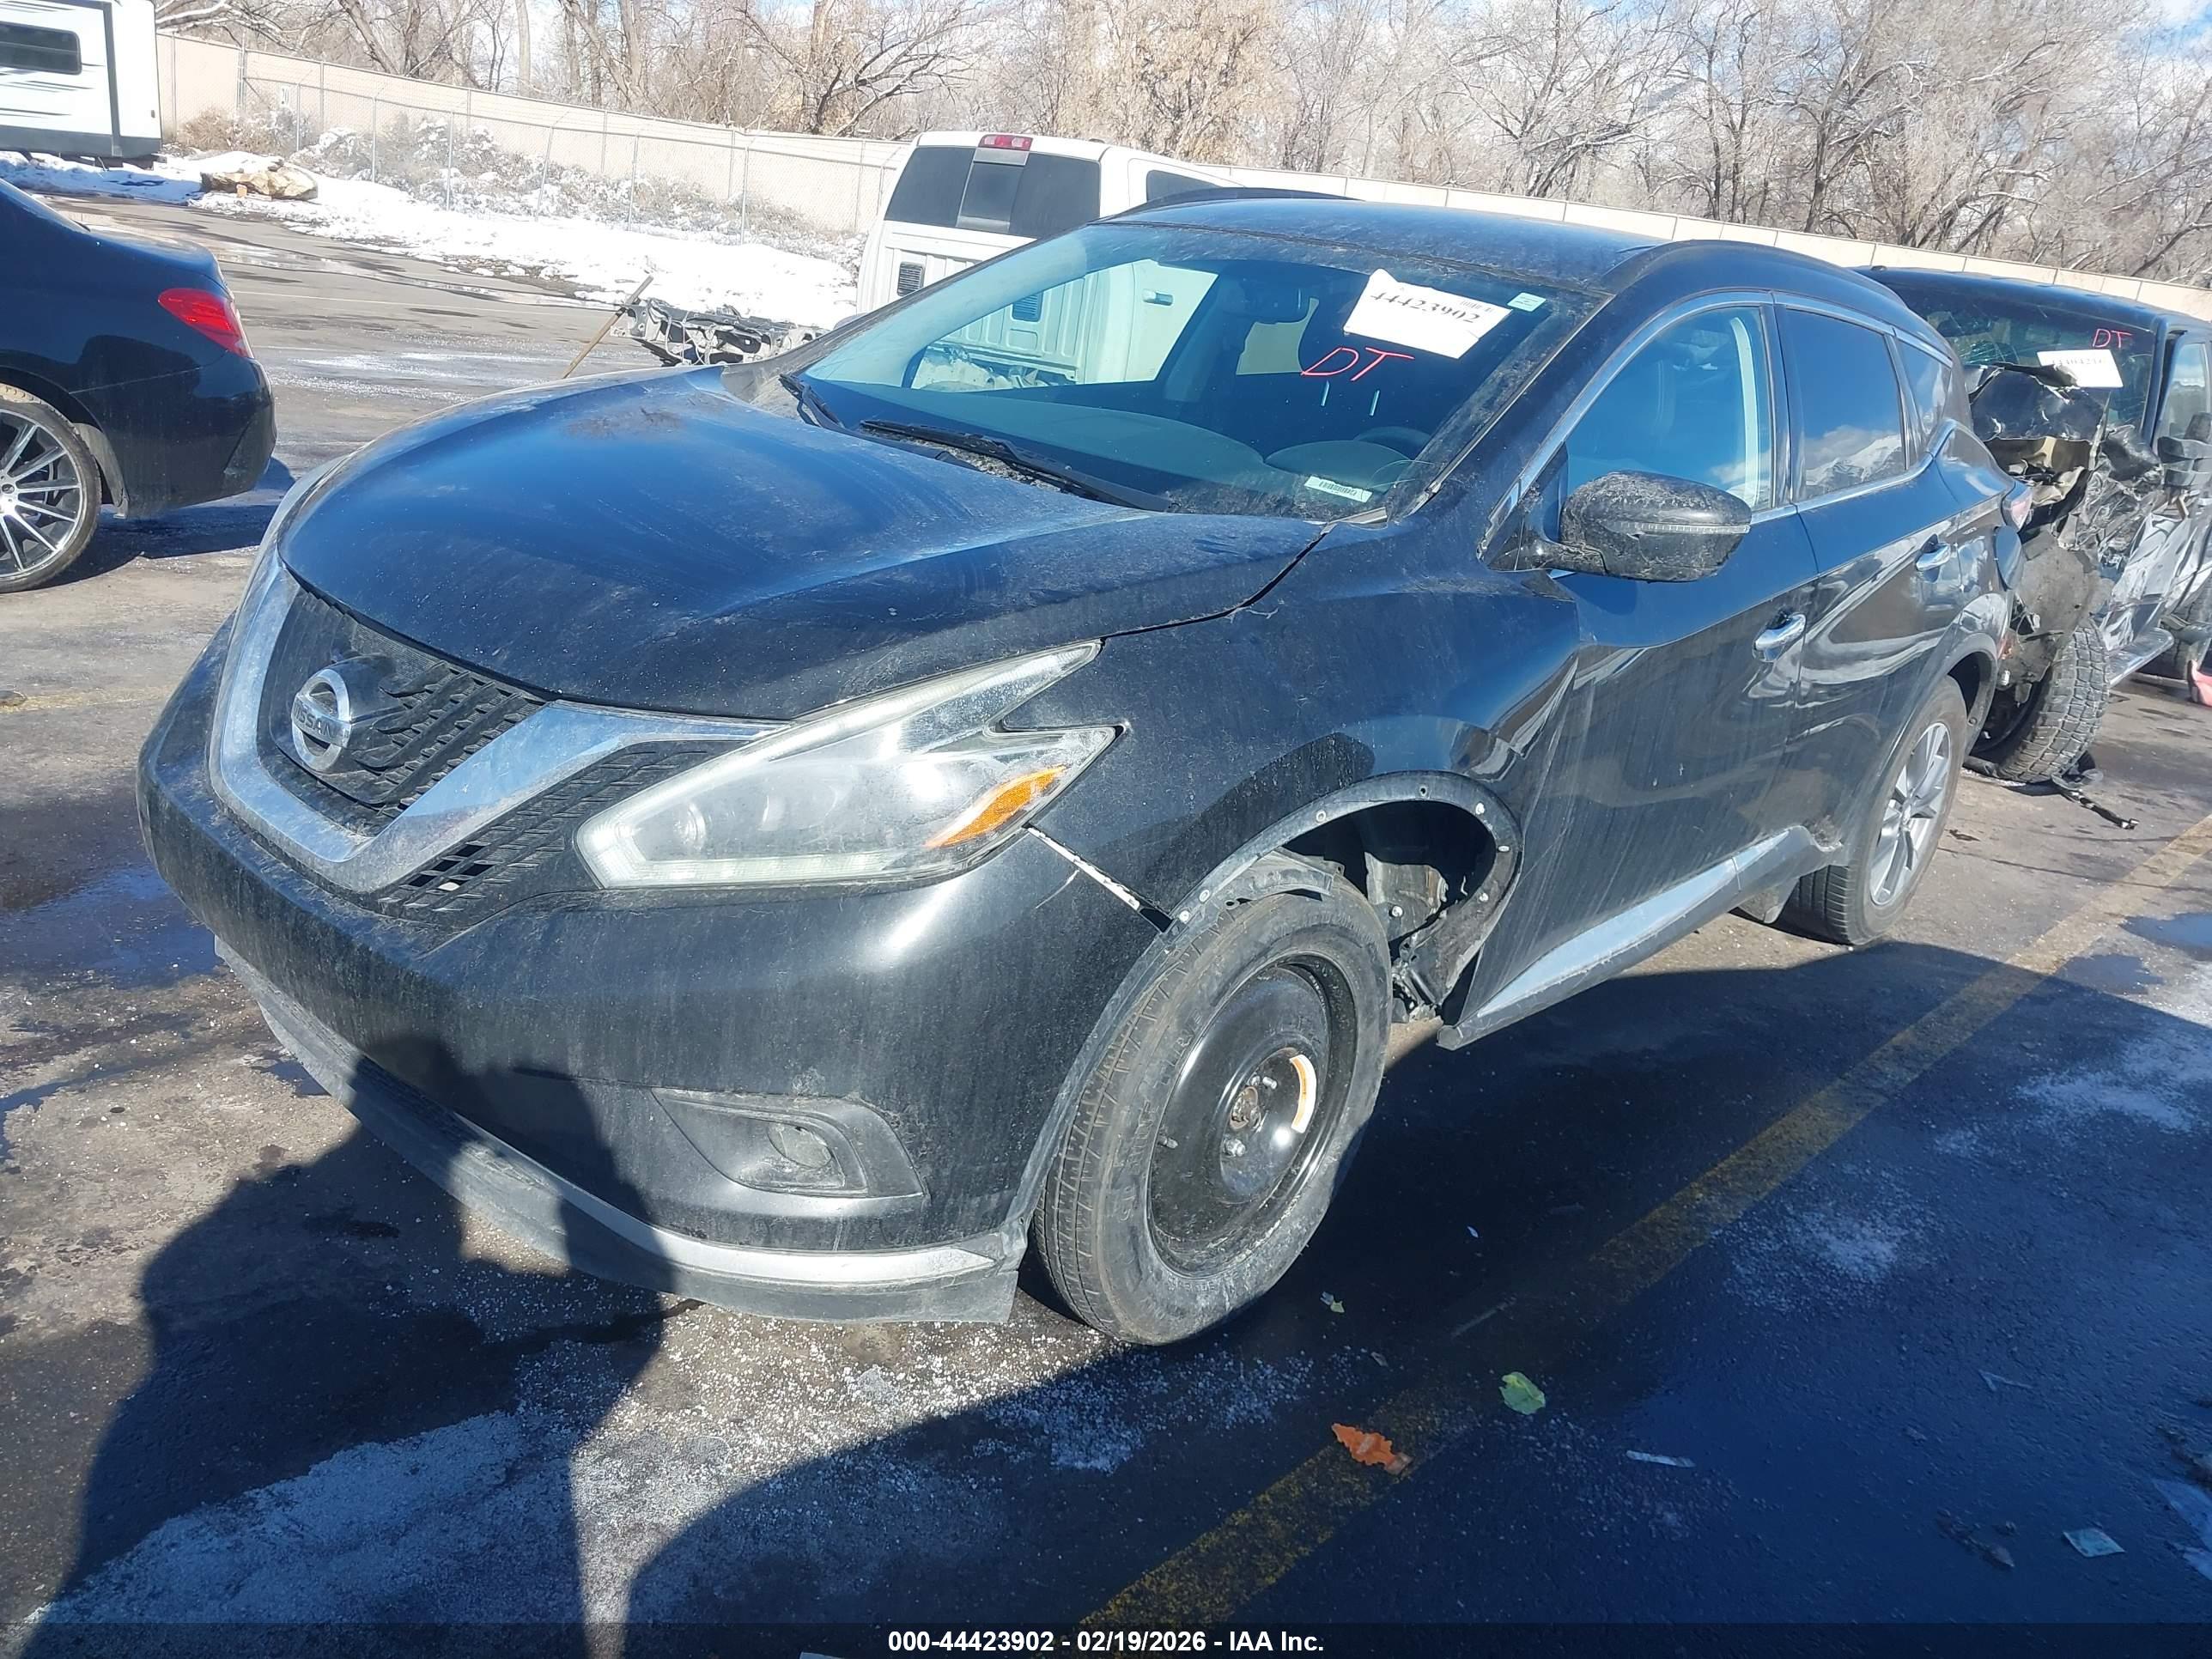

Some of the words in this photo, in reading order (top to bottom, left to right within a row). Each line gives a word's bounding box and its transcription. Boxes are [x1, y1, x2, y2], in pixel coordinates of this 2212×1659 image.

[1370, 291, 1480, 324] 44423902
[2092, 328, 2133, 348] DT
[1300, 346, 1415, 382] DT
[294, 701, 341, 739] NISSAN
